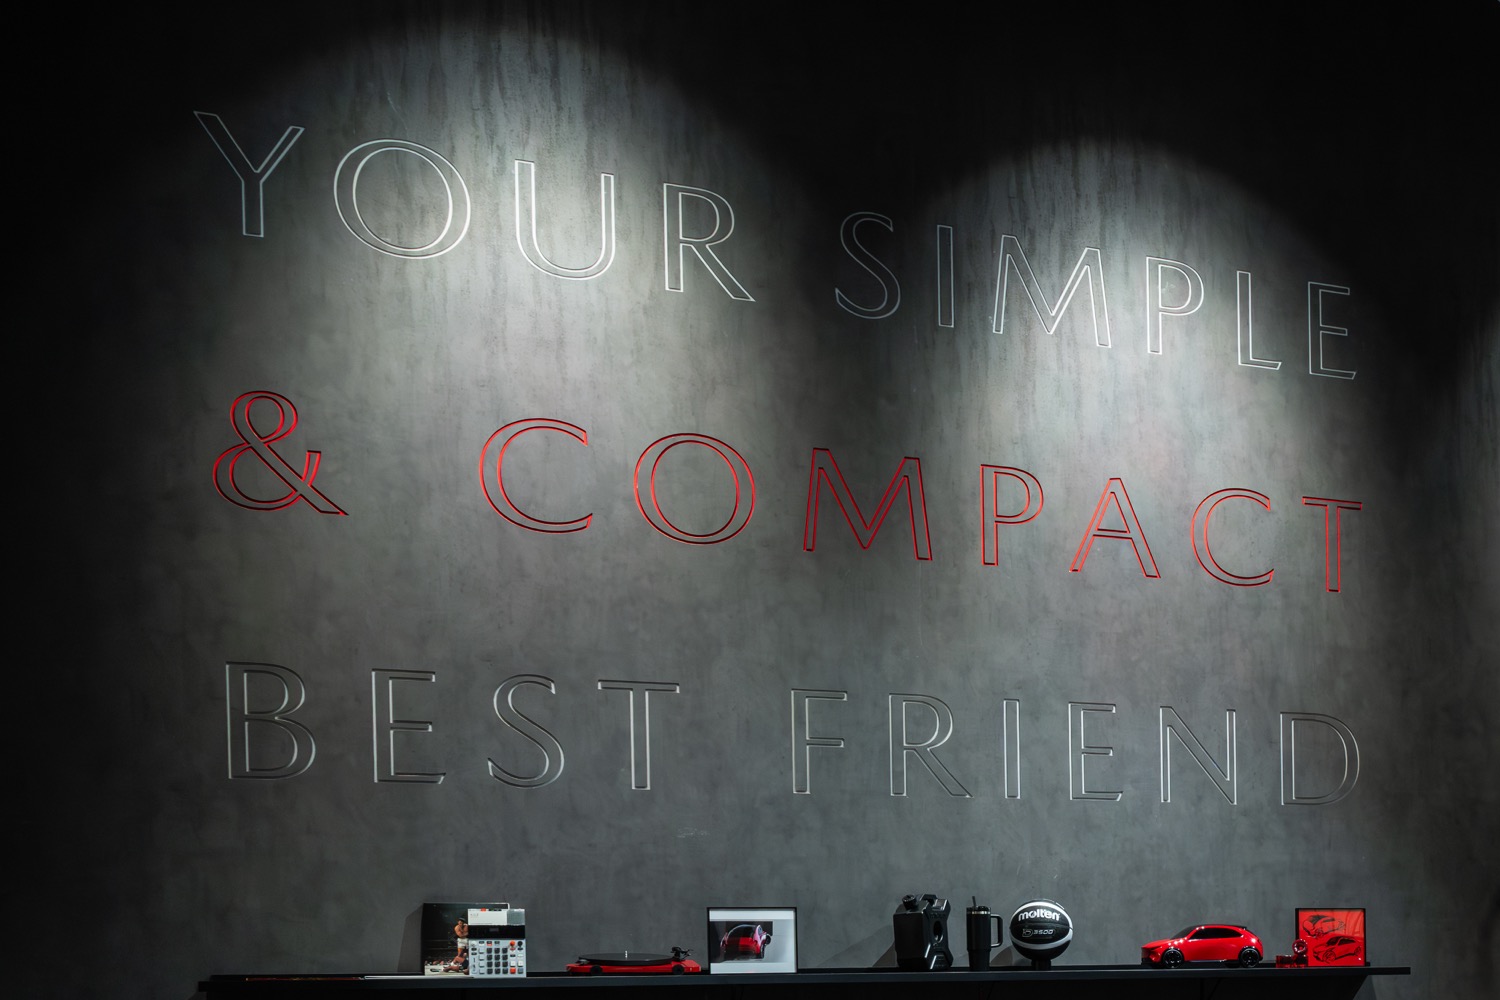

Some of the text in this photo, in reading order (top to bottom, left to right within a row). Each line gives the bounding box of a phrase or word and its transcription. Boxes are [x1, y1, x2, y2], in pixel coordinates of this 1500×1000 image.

[193, 110, 1357, 380] YOUR SIMPLE
[212, 390, 1363, 593] & COMPACT
[225, 661, 1360, 805] BEST FRIEND
[1018, 909, 1060, 921] molten
